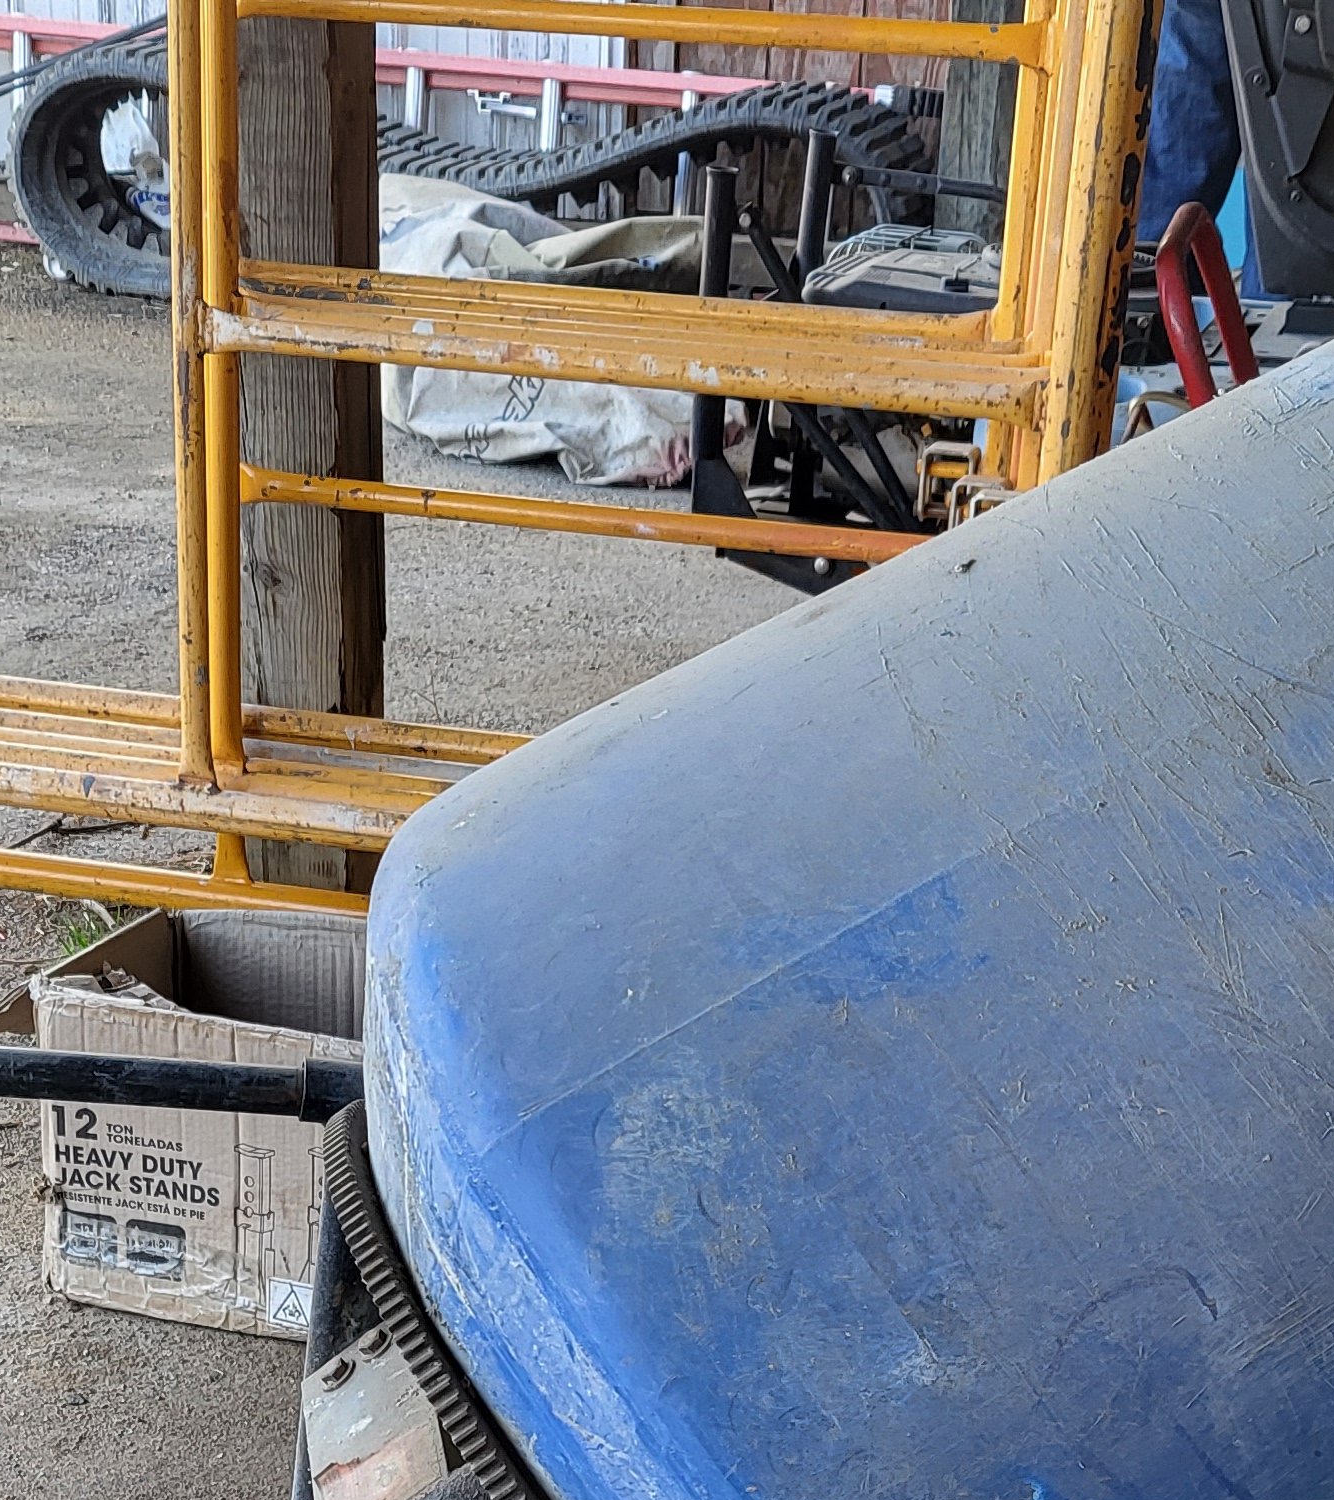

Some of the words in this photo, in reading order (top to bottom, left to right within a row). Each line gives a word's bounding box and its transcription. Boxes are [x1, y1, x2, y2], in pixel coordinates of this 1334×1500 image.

[52, 1104, 98, 1141] 12
[106, 1123, 133, 1135] TON
[107, 1133, 183, 1152] TONELADAS
[54, 1144, 133, 1170] HEAVY
[142, 1154, 203, 1181] DUTY
[54, 1167, 122, 1192] JACK
[129, 1175, 220, 1207] STANDS
[115, 1199, 144, 1211] JACK
[147, 1202, 170, 1215] ESTÁ
[174, 1208, 186, 1217] DE
[190, 1210, 205, 1220] PIE
